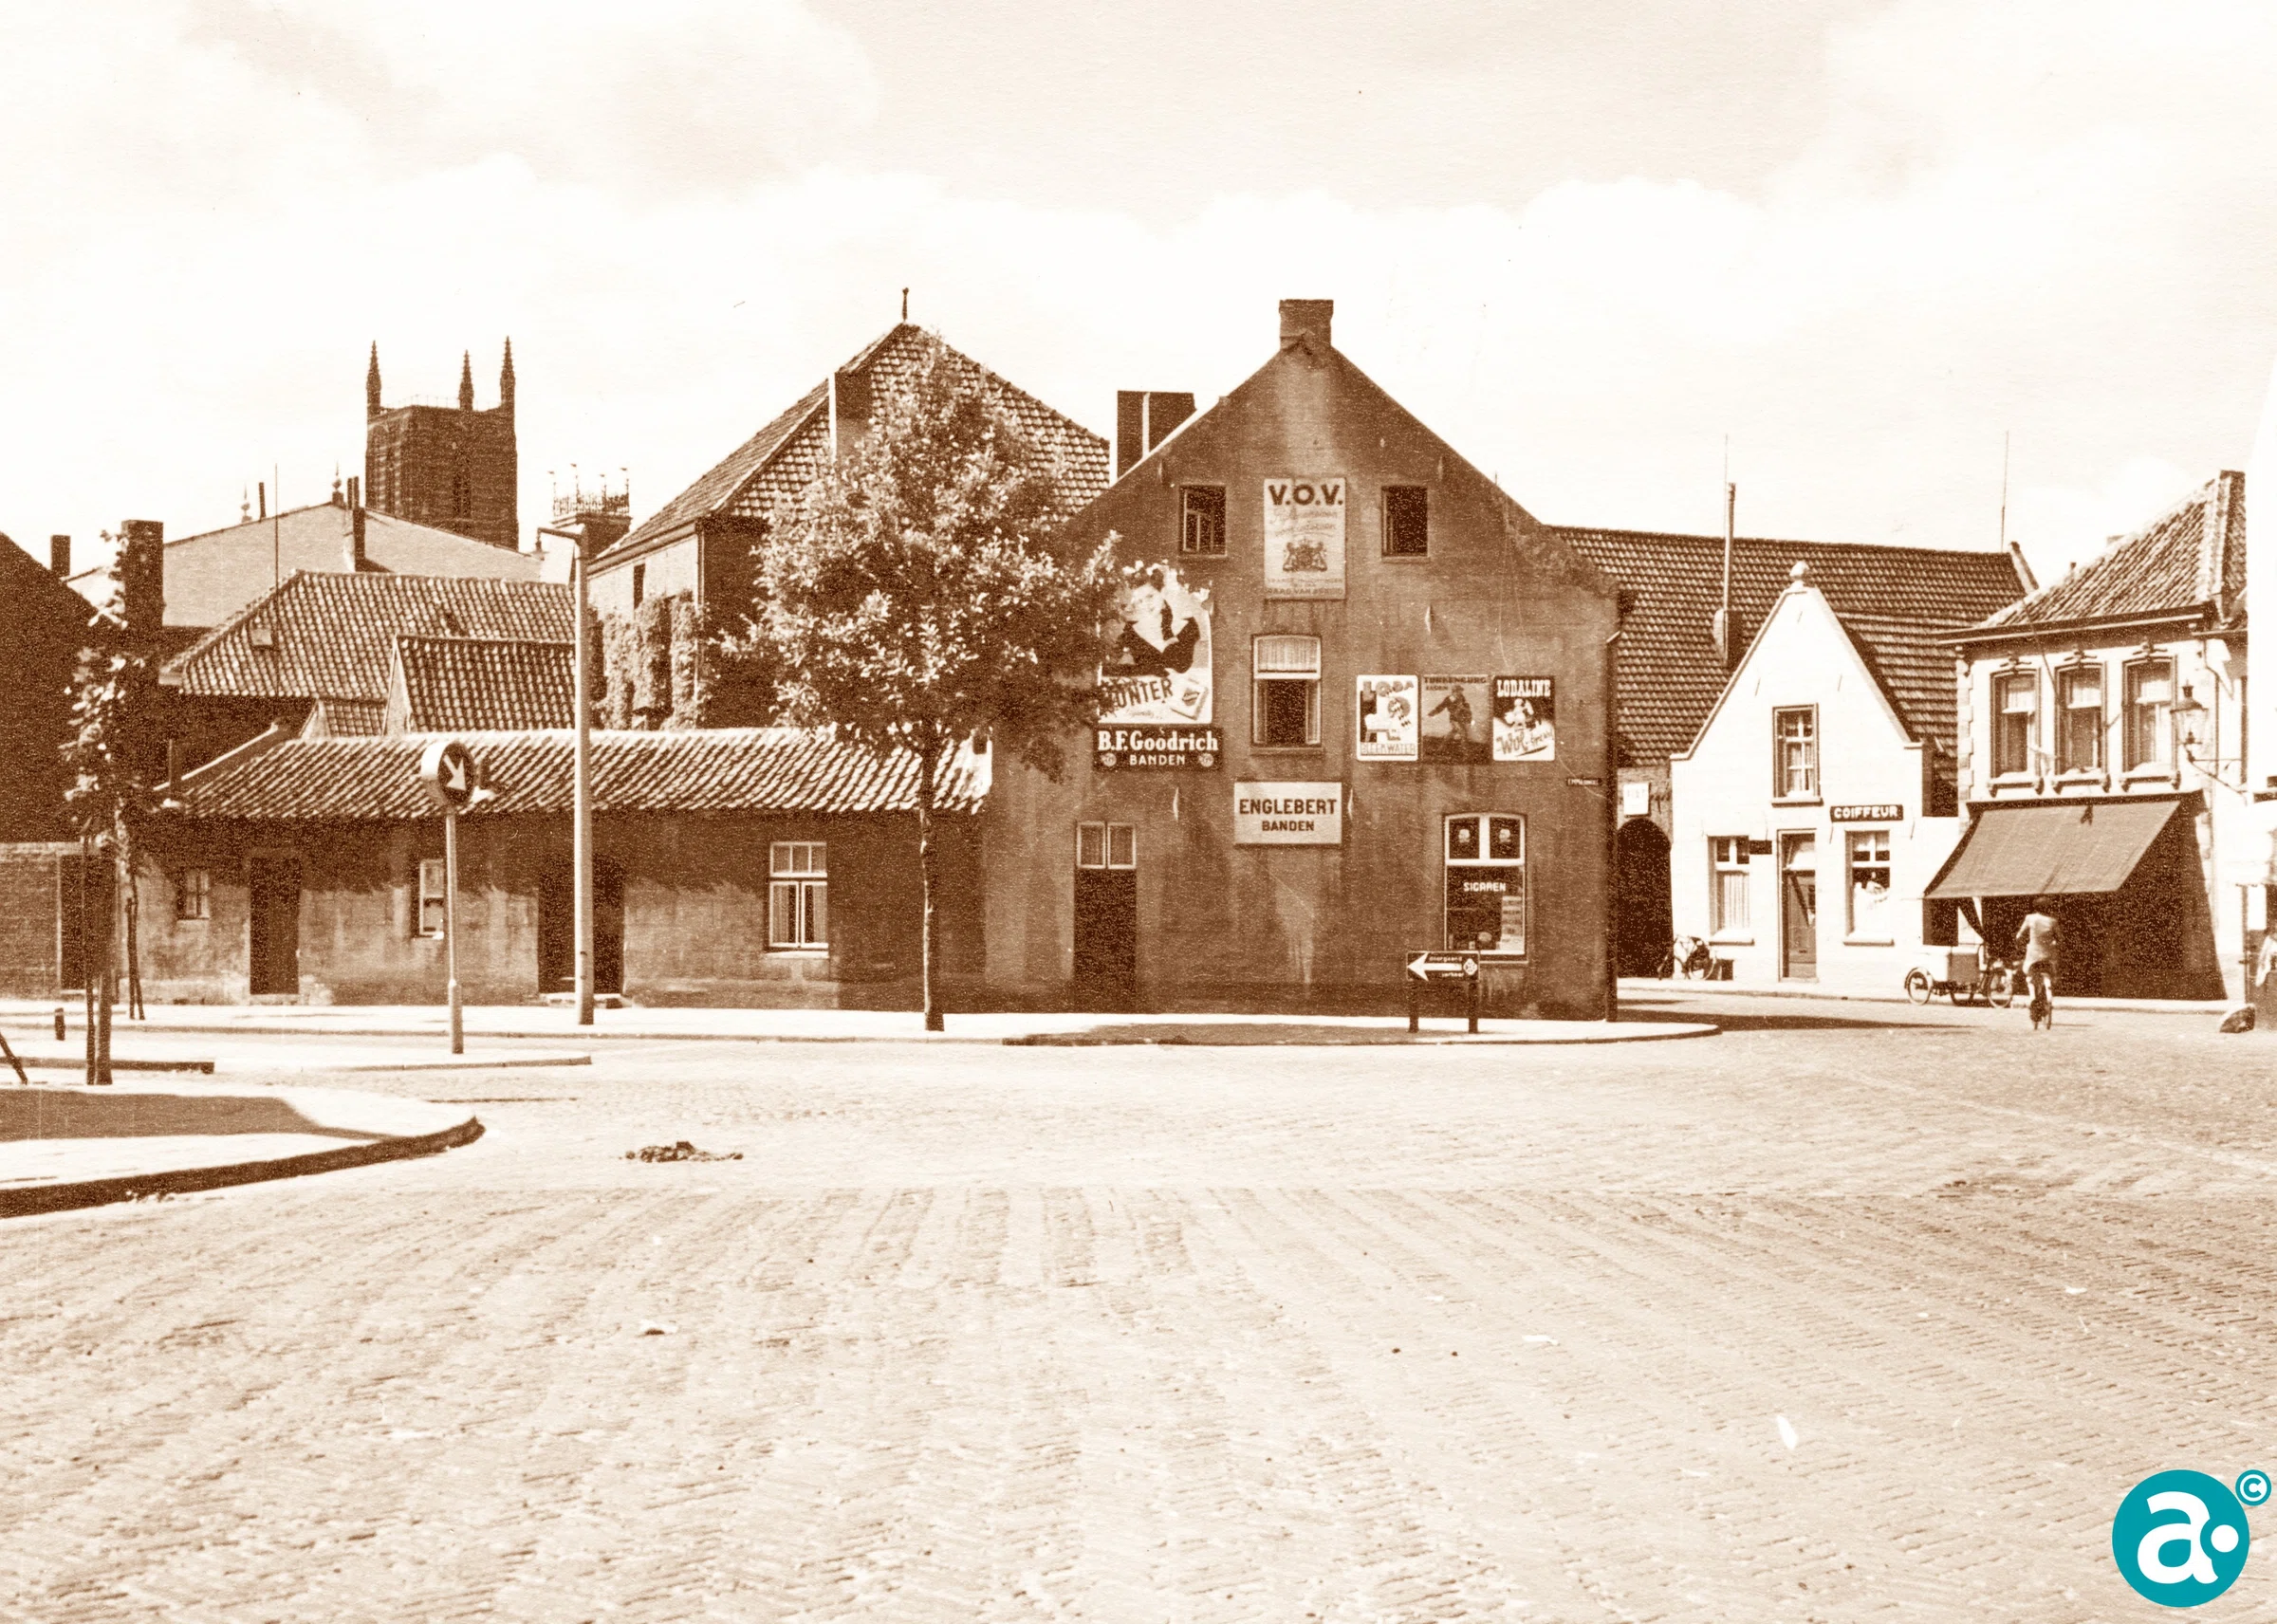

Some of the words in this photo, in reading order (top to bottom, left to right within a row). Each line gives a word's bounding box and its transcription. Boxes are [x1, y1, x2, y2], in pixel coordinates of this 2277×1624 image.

[1268, 484, 1343, 506] V.O.V.
[1103, 676, 1174, 710] UNTER
[1496, 679, 1551, 697] LODALINE
[1129, 754, 1185, 766] BANDEN
[1239, 799, 1337, 815] ENGLEBERT
[1833, 805, 1898, 819] COIFFEUR
[1262, 821, 1314, 831] BANDEN
[1463, 881, 1507, 893] SIGAREN
